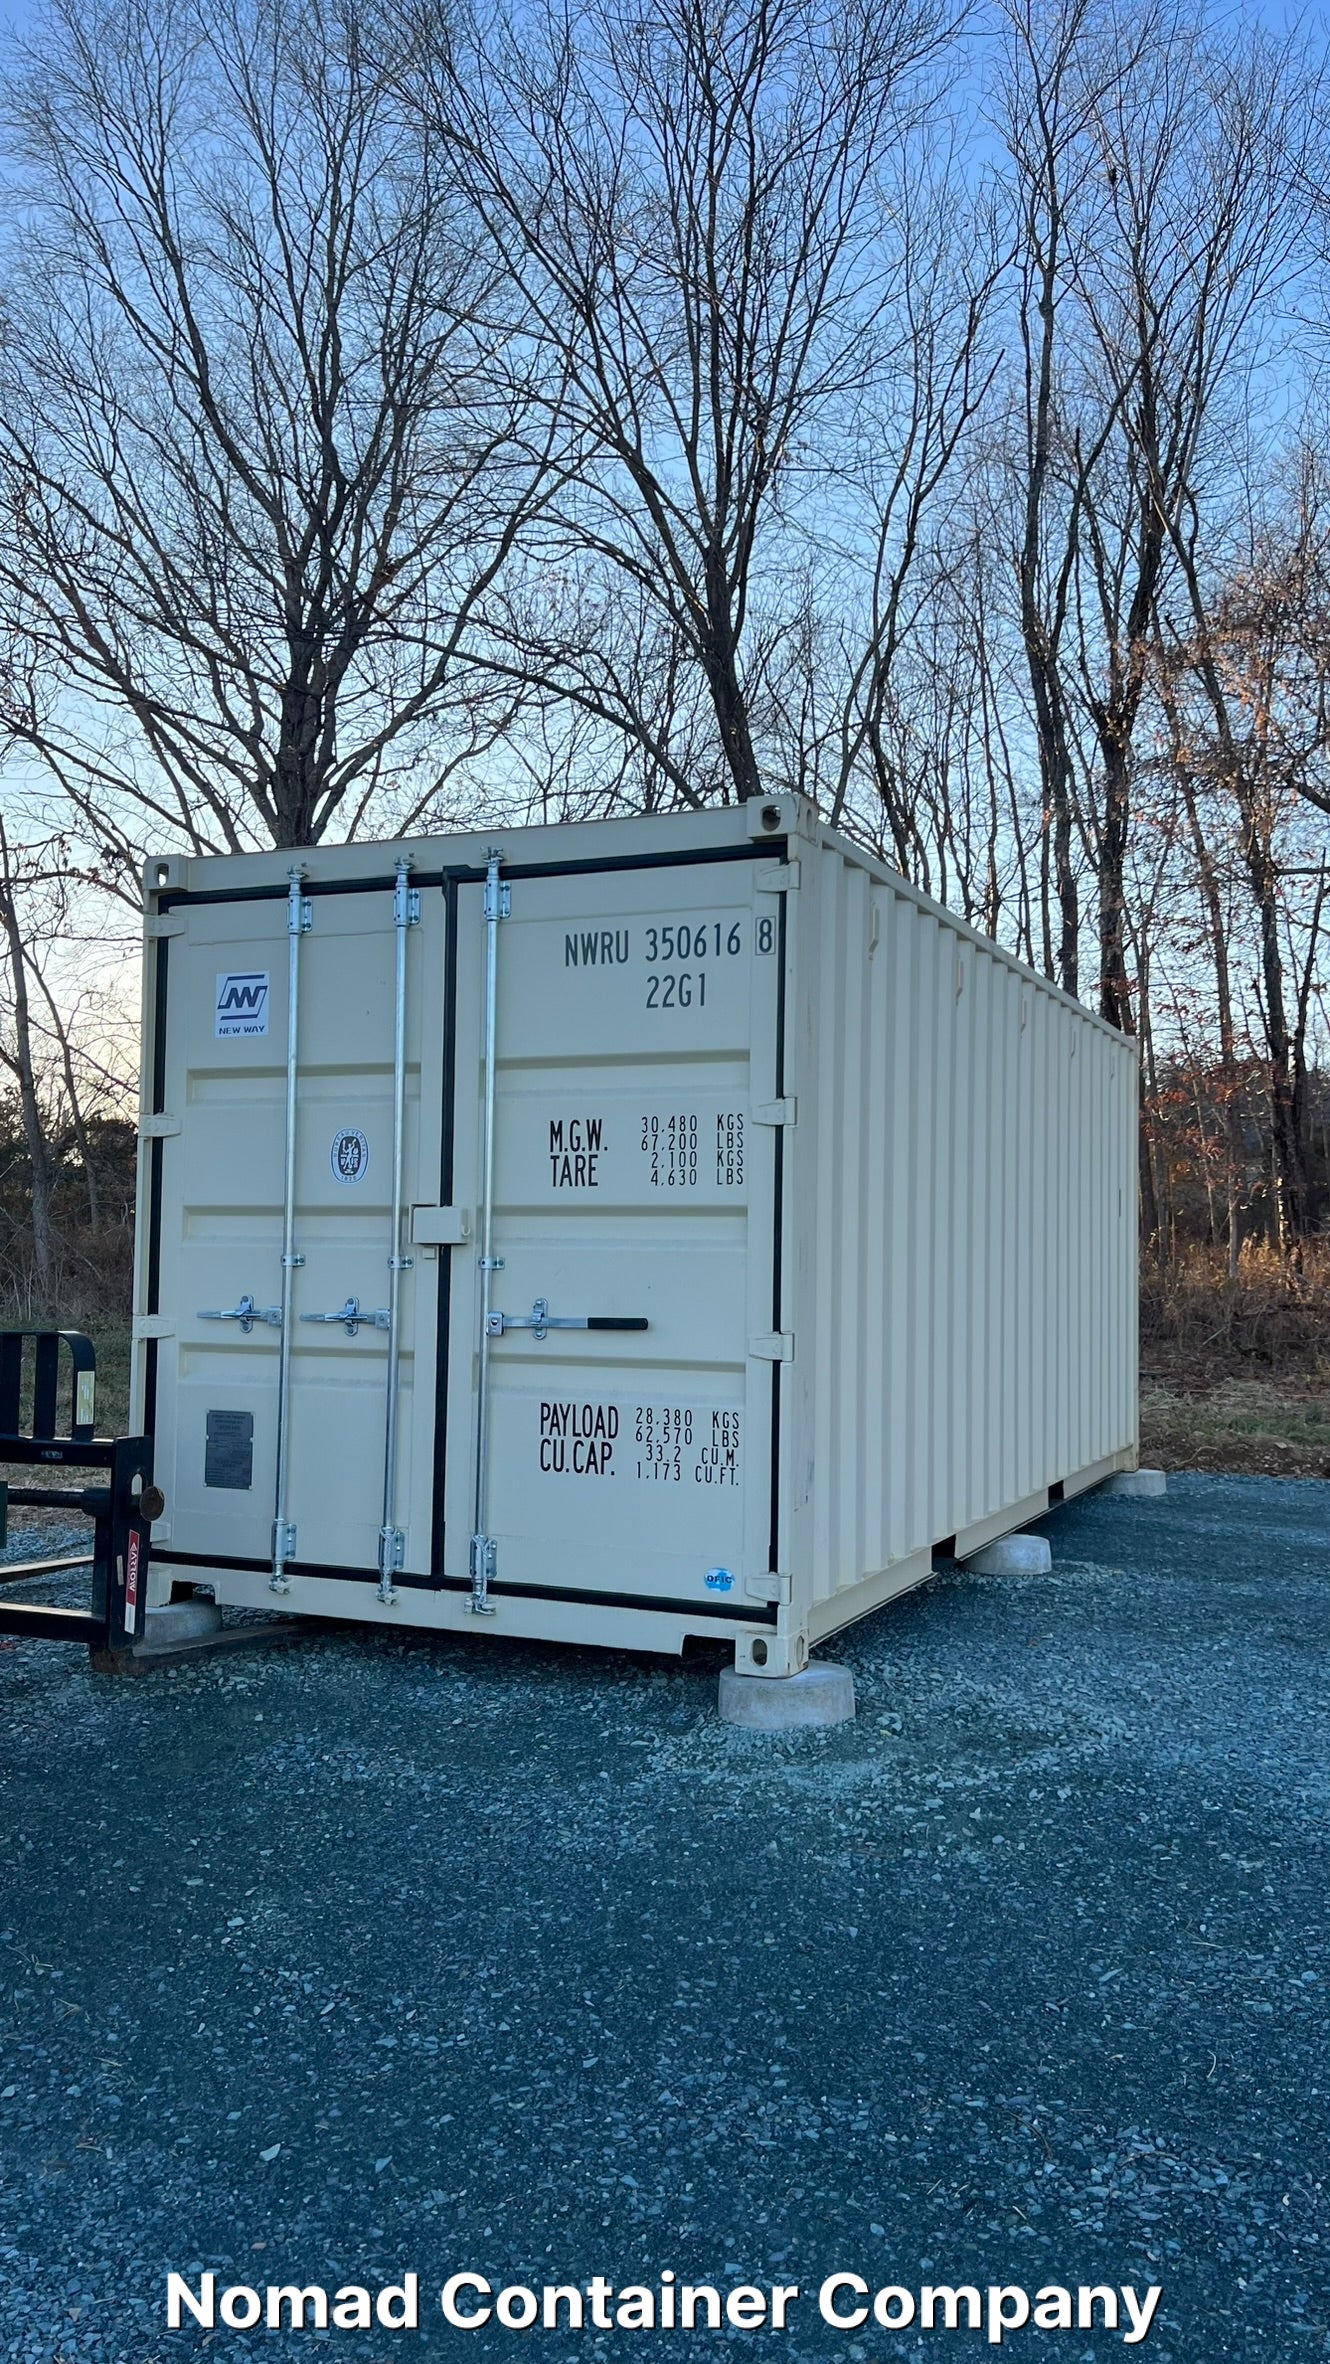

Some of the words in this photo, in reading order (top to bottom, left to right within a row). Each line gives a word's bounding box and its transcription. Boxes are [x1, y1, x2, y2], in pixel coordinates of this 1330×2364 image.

[565, 930, 629, 967] NWRU
[645, 922, 741, 962] 350616
[758, 918, 773, 953] 8
[646, 972, 706, 1009] 22G1
[219, 1027, 241, 1035] NEW
[243, 1025, 265, 1033] WAY
[550, 1119, 608, 1152] M.G.W.
[716, 1113, 744, 1131] KGS
[716, 1132, 744, 1149] LBS
[550, 1154, 599, 1187] TARE
[716, 1150, 744, 1167] KGS
[716, 1168, 744, 1185] LBS
[540, 1402, 619, 1439] PAYLOAD
[712, 1411, 740, 1429] KGS
[712, 1429, 740, 1448] LBS
[540, 1438, 616, 1476] CU.CAP.
[645, 1443, 682, 1463] 33.2
[701, 1447, 740, 1467] CU.M.
[695, 1465, 740, 1486] CU.FT.
[129, 1552, 137, 1592] ARROW
[706, 1575, 732, 1584] OFIC
